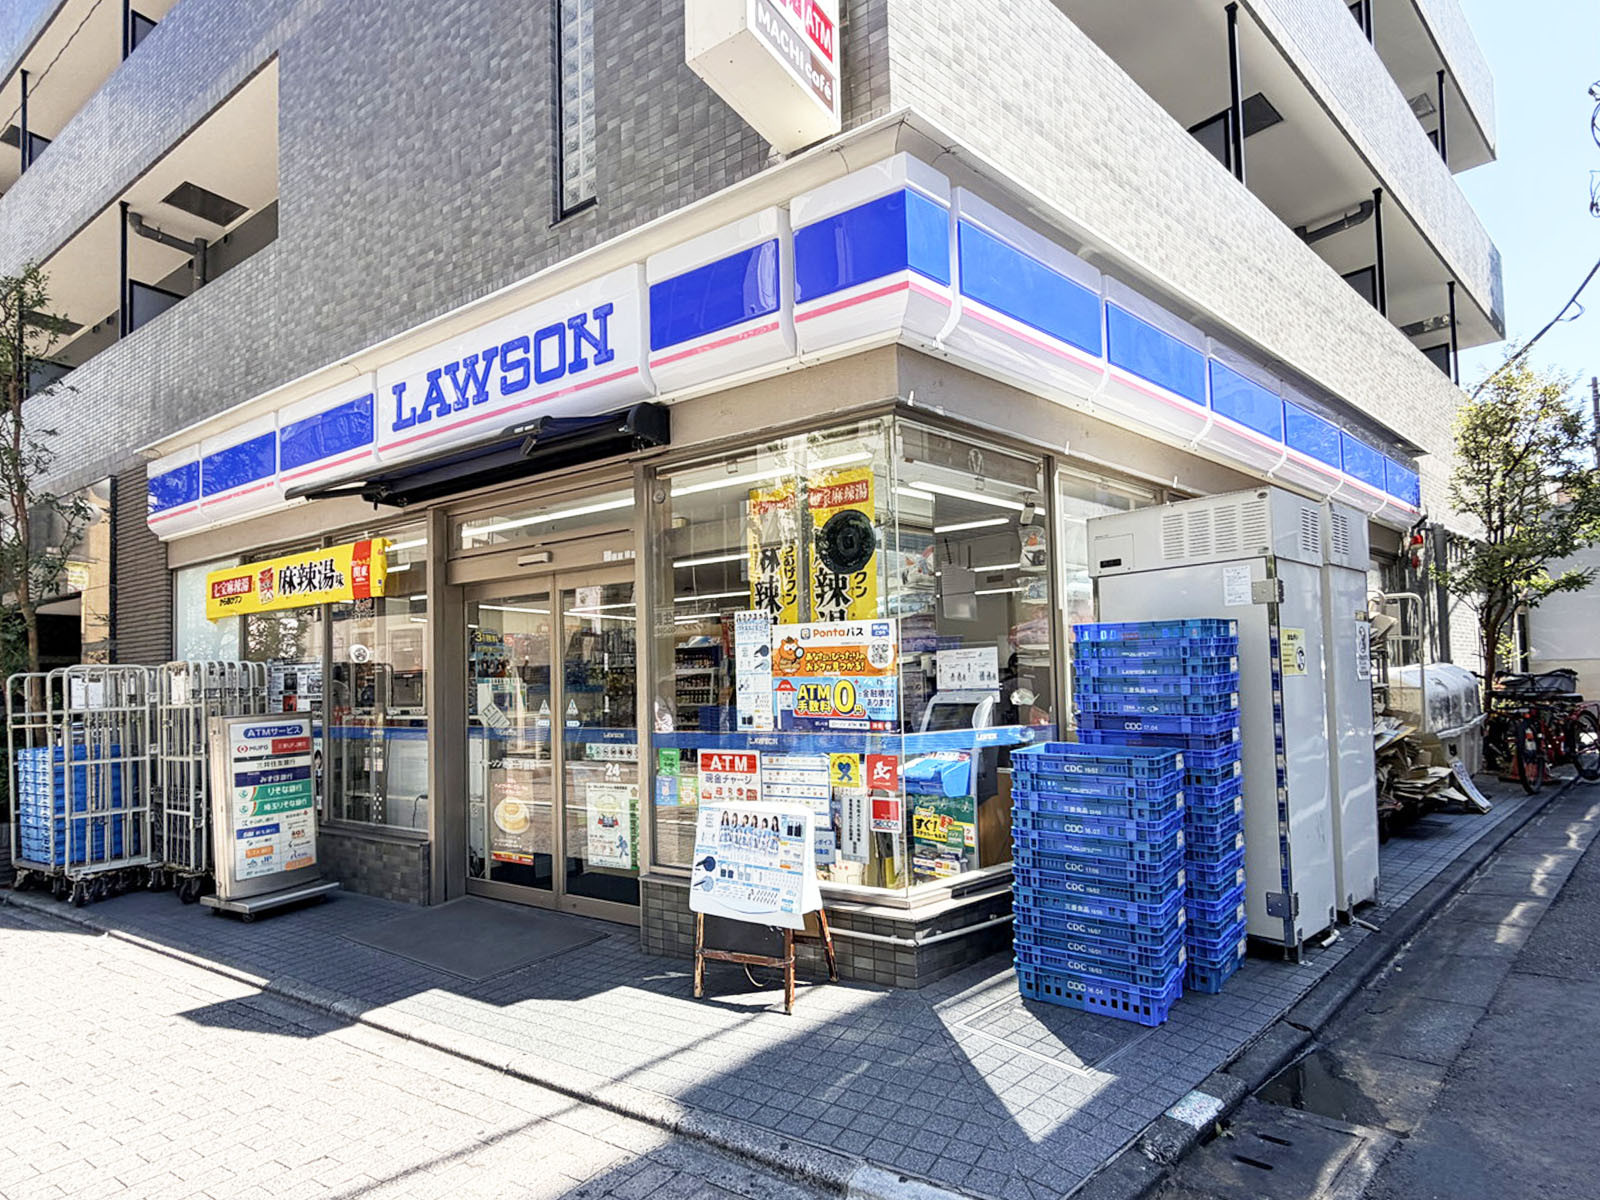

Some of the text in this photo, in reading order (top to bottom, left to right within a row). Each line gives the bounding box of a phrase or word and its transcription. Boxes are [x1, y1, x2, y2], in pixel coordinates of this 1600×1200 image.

[804, 5, 833, 54] ATM
[757, 2, 805, 71] MACHI
[804, 60, 832, 101] café
[391, 302, 615, 432] LAWSON
[796, 683, 831, 700] ATM
[796, 700, 832, 714] 手数料
[247, 726, 302, 738] ATMサービス
[1124, 722, 1143, 731] CDC
[605, 762, 621, 776] 24
[709, 755, 748, 772] ATM
[1063, 764, 1083, 774] CDC
[705, 773, 753, 785] 現金チャージ
[1063, 823, 1083, 834] CDC
[1064, 862, 1083, 872] CDC
[1065, 882, 1084, 892] CDC
[1066, 922, 1086, 932] CDC
[1067, 942, 1086, 952] CDC
[1067, 961, 1087, 971] CDC
[1067, 981, 1087, 992] CDC
